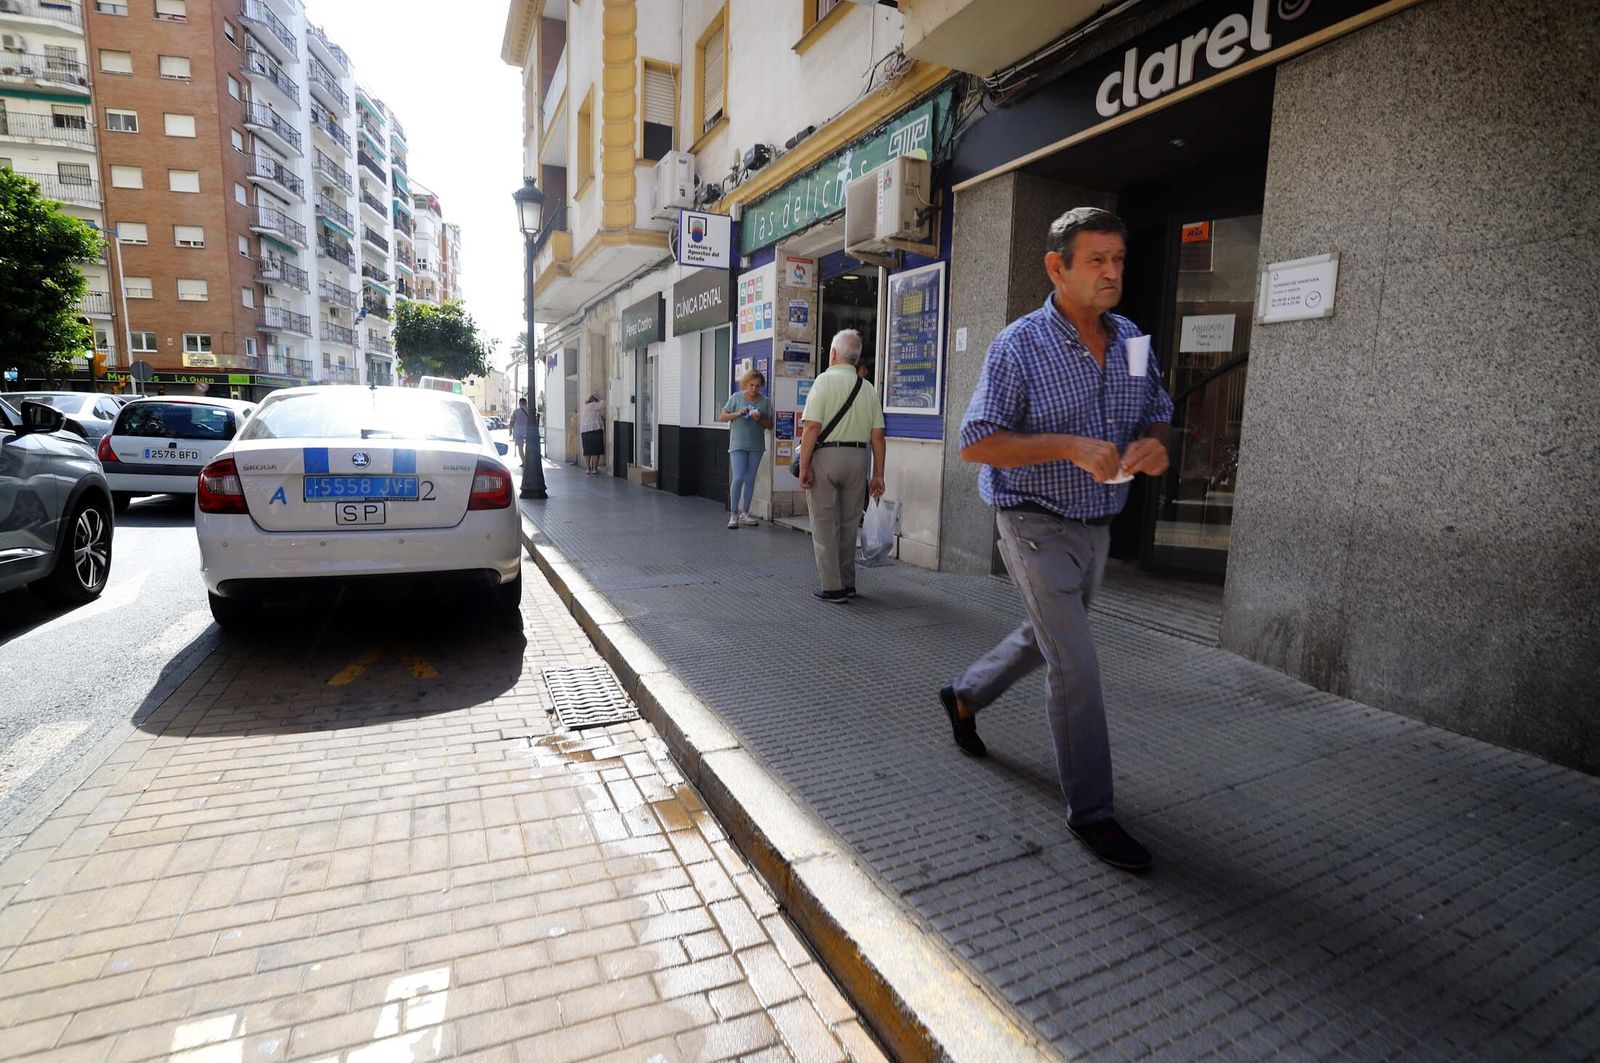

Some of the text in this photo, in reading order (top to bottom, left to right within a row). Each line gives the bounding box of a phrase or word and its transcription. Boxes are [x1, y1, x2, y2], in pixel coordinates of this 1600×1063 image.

[1095, 0, 1272, 117] clarel
[751, 209, 774, 246] las
[675, 295, 698, 319] CLÍNICA
[698, 286, 722, 311] DENTAL
[151, 450, 198, 460] 2576 BFD
[269, 486, 287, 505] A
[321, 478, 413, 494] 5558 JVF
[420, 480, 437, 501] 2
